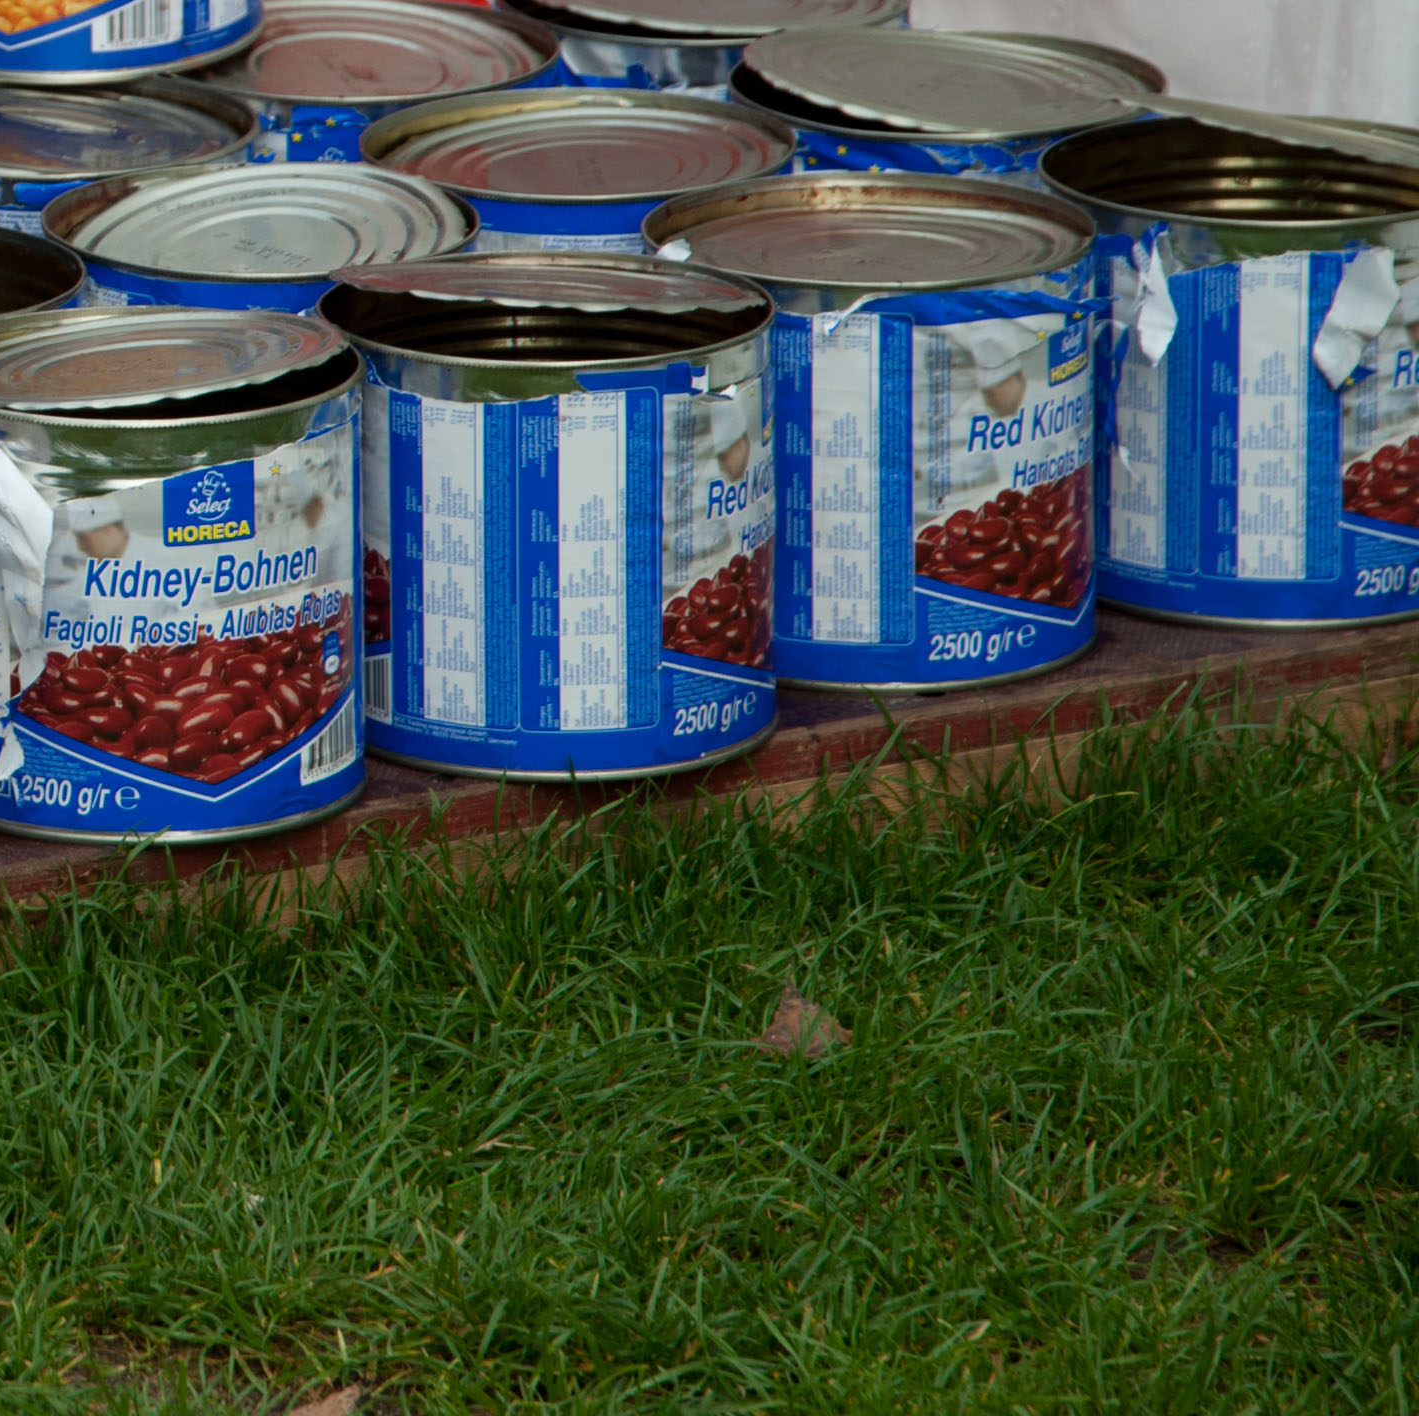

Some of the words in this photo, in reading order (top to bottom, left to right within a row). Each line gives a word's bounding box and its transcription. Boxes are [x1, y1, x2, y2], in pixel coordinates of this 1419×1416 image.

[967, 407, 1025, 452] Red
[1013, 448, 1076, 489] Haricots
[186, 496, 231, 516] Select
[707, 470, 749, 519] Red
[167, 520, 251, 544] HORECA
[84, 544, 317, 607] Kidney-Bohnen
[1354, 565, 1405, 596] 2500
[45, 611, 123, 650] Fagioli
[130, 613, 199, 645] Rossi
[219, 608, 296, 641] Alubias
[300, 589, 341, 629] Rojas
[928, 630, 981, 661] 2500
[673, 702, 718, 736] 2500
[21, 775, 72, 806] 2500
